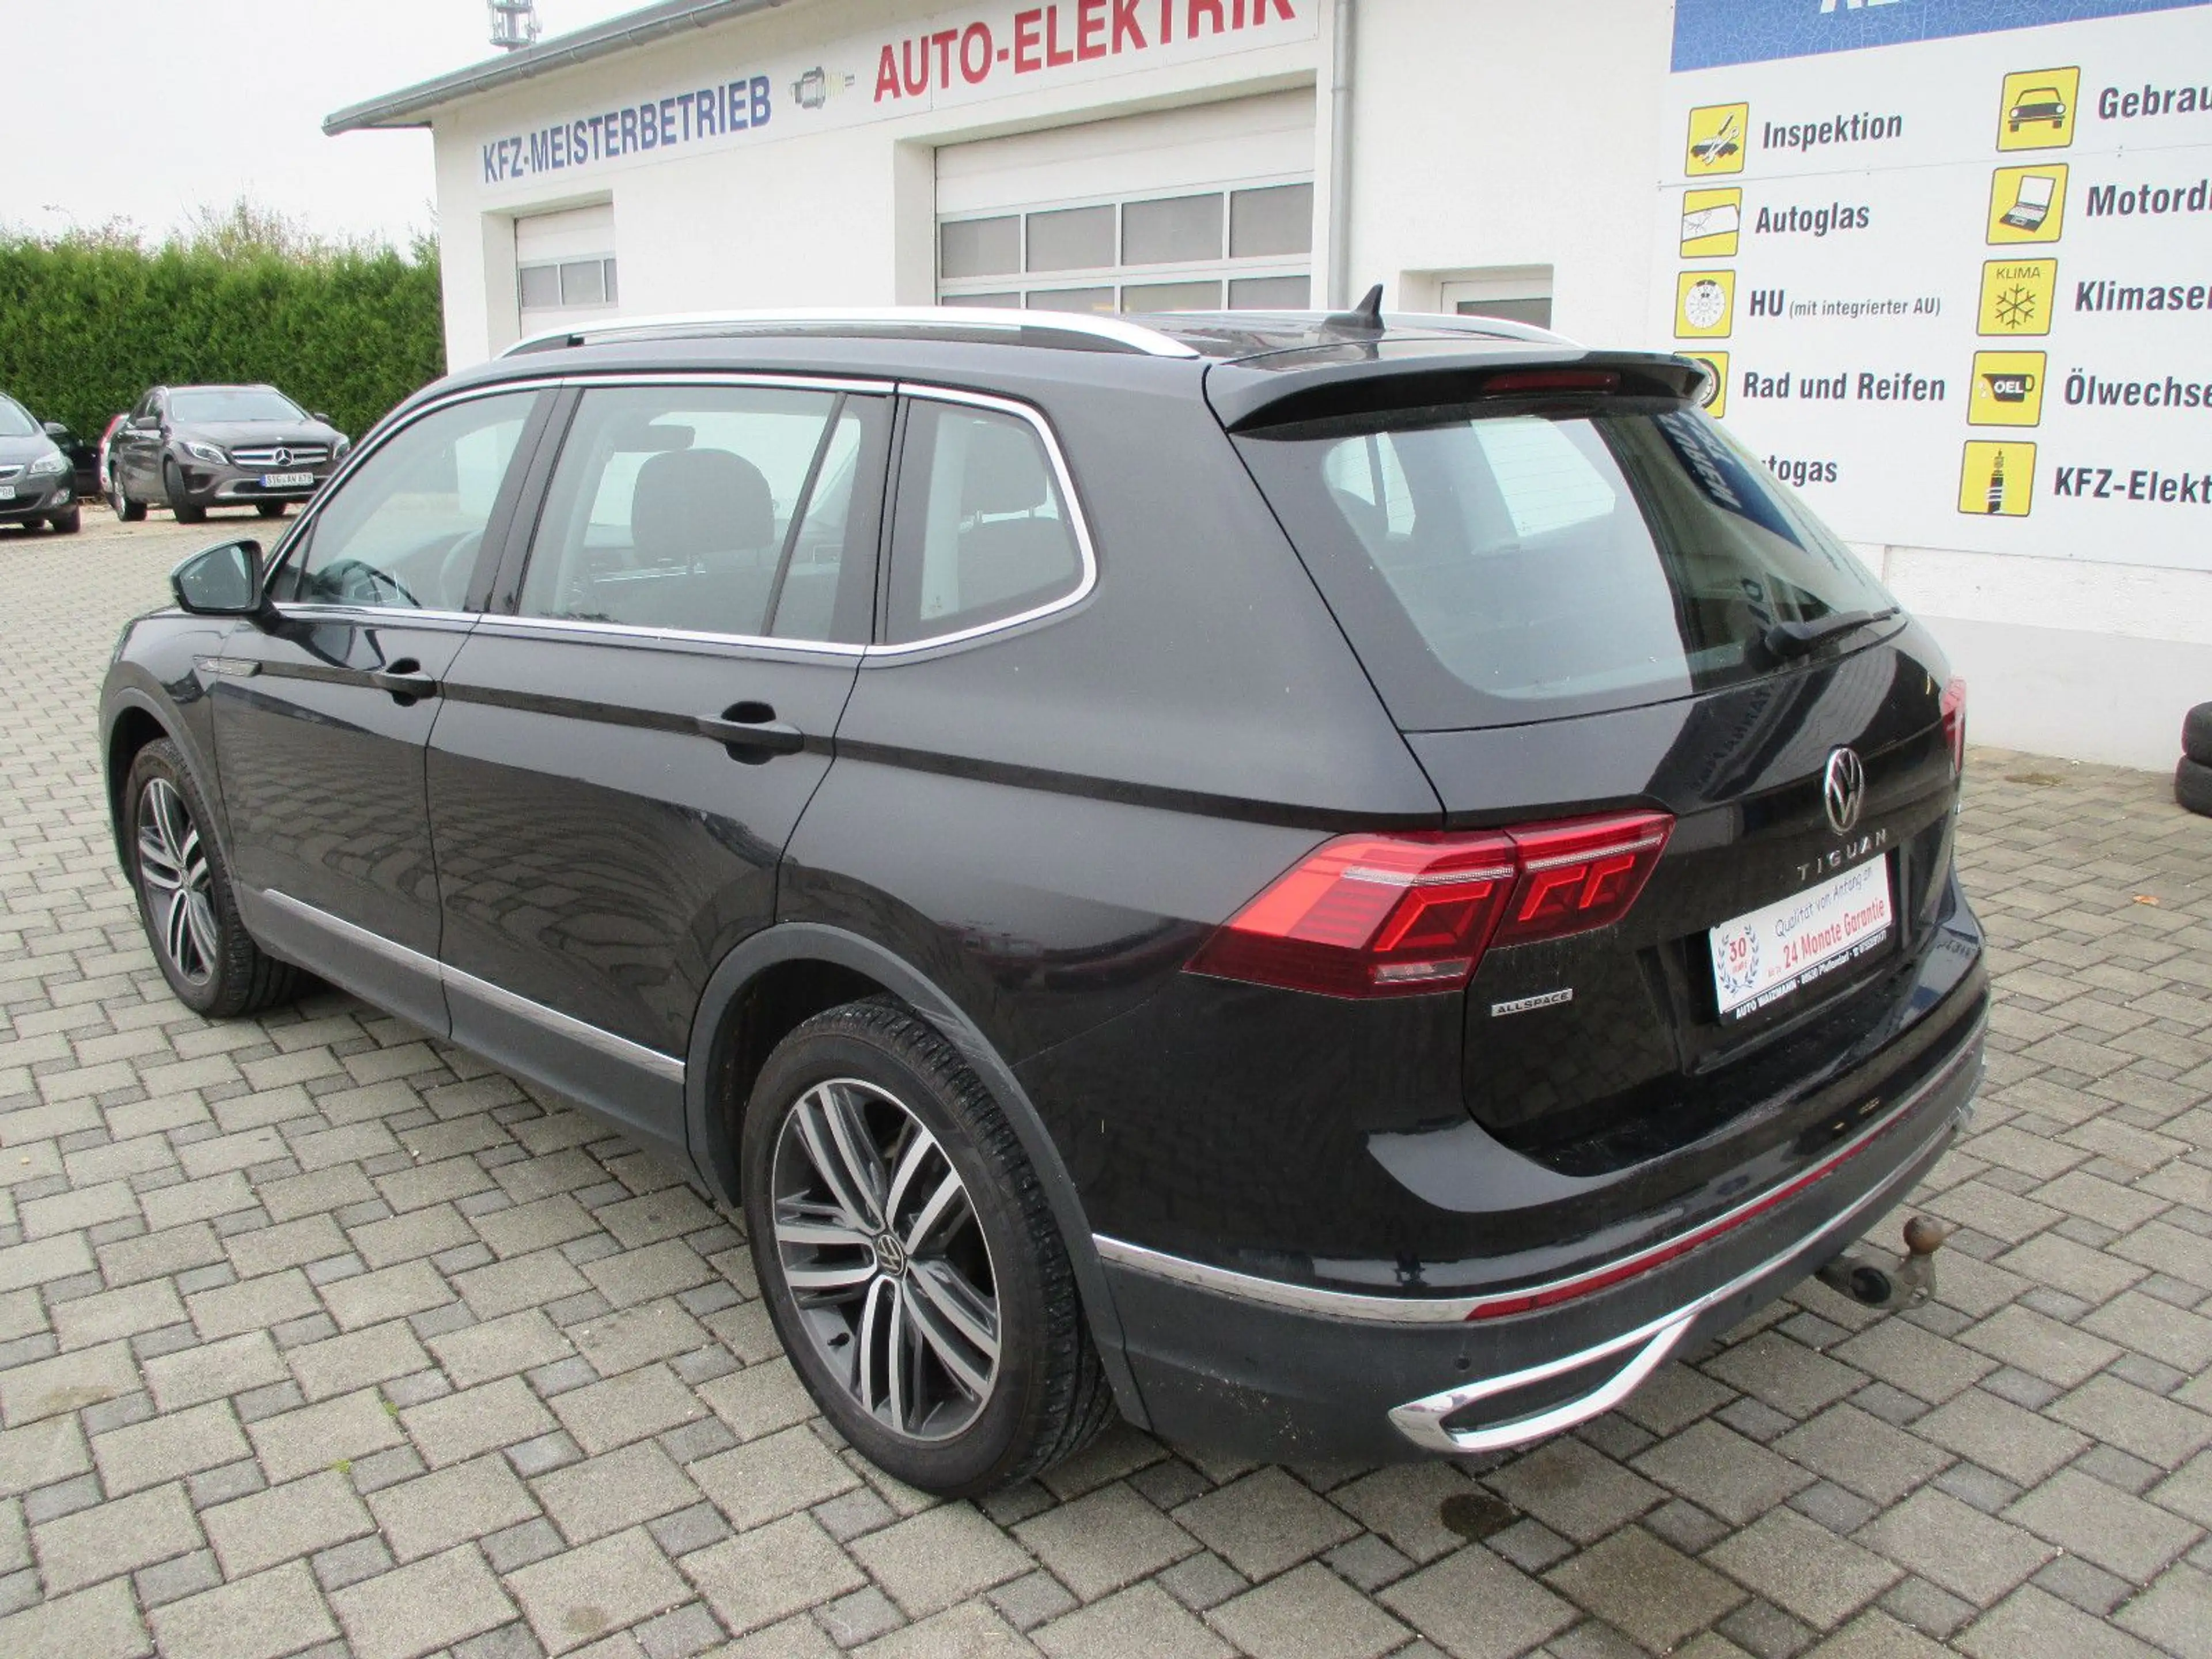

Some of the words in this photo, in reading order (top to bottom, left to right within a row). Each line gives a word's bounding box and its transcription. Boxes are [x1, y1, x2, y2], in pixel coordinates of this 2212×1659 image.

[483, 75, 772, 183] KFZ-MEISTERBETRIEB
[1763, 112, 1902, 151] Inspektion
[2086, 179, 2212, 217] Motord
[1755, 202, 1870, 237] Autoglas
[1996, 267, 2040, 279] KLIMA
[1750, 289, 1785, 317] HU
[1789, 300, 1816, 319] (mit
[1822, 298, 1908, 319] integrierter
[1913, 297, 1941, 317] AU)
[1744, 372, 1790, 399] Rad
[1801, 373, 1847, 399] und
[1858, 373, 1945, 401] Reifen
[1994, 381, 2023, 393] OEL
[1762, 454, 1838, 487] togas
[1797, 828, 1888, 881] TIGUAN
[1783, 942, 1798, 969] 24
[1801, 923, 1842, 959] Monate
[1843, 897, 1884, 937] Garantie
[1498, 992, 1569, 1013] ALLSPACE
